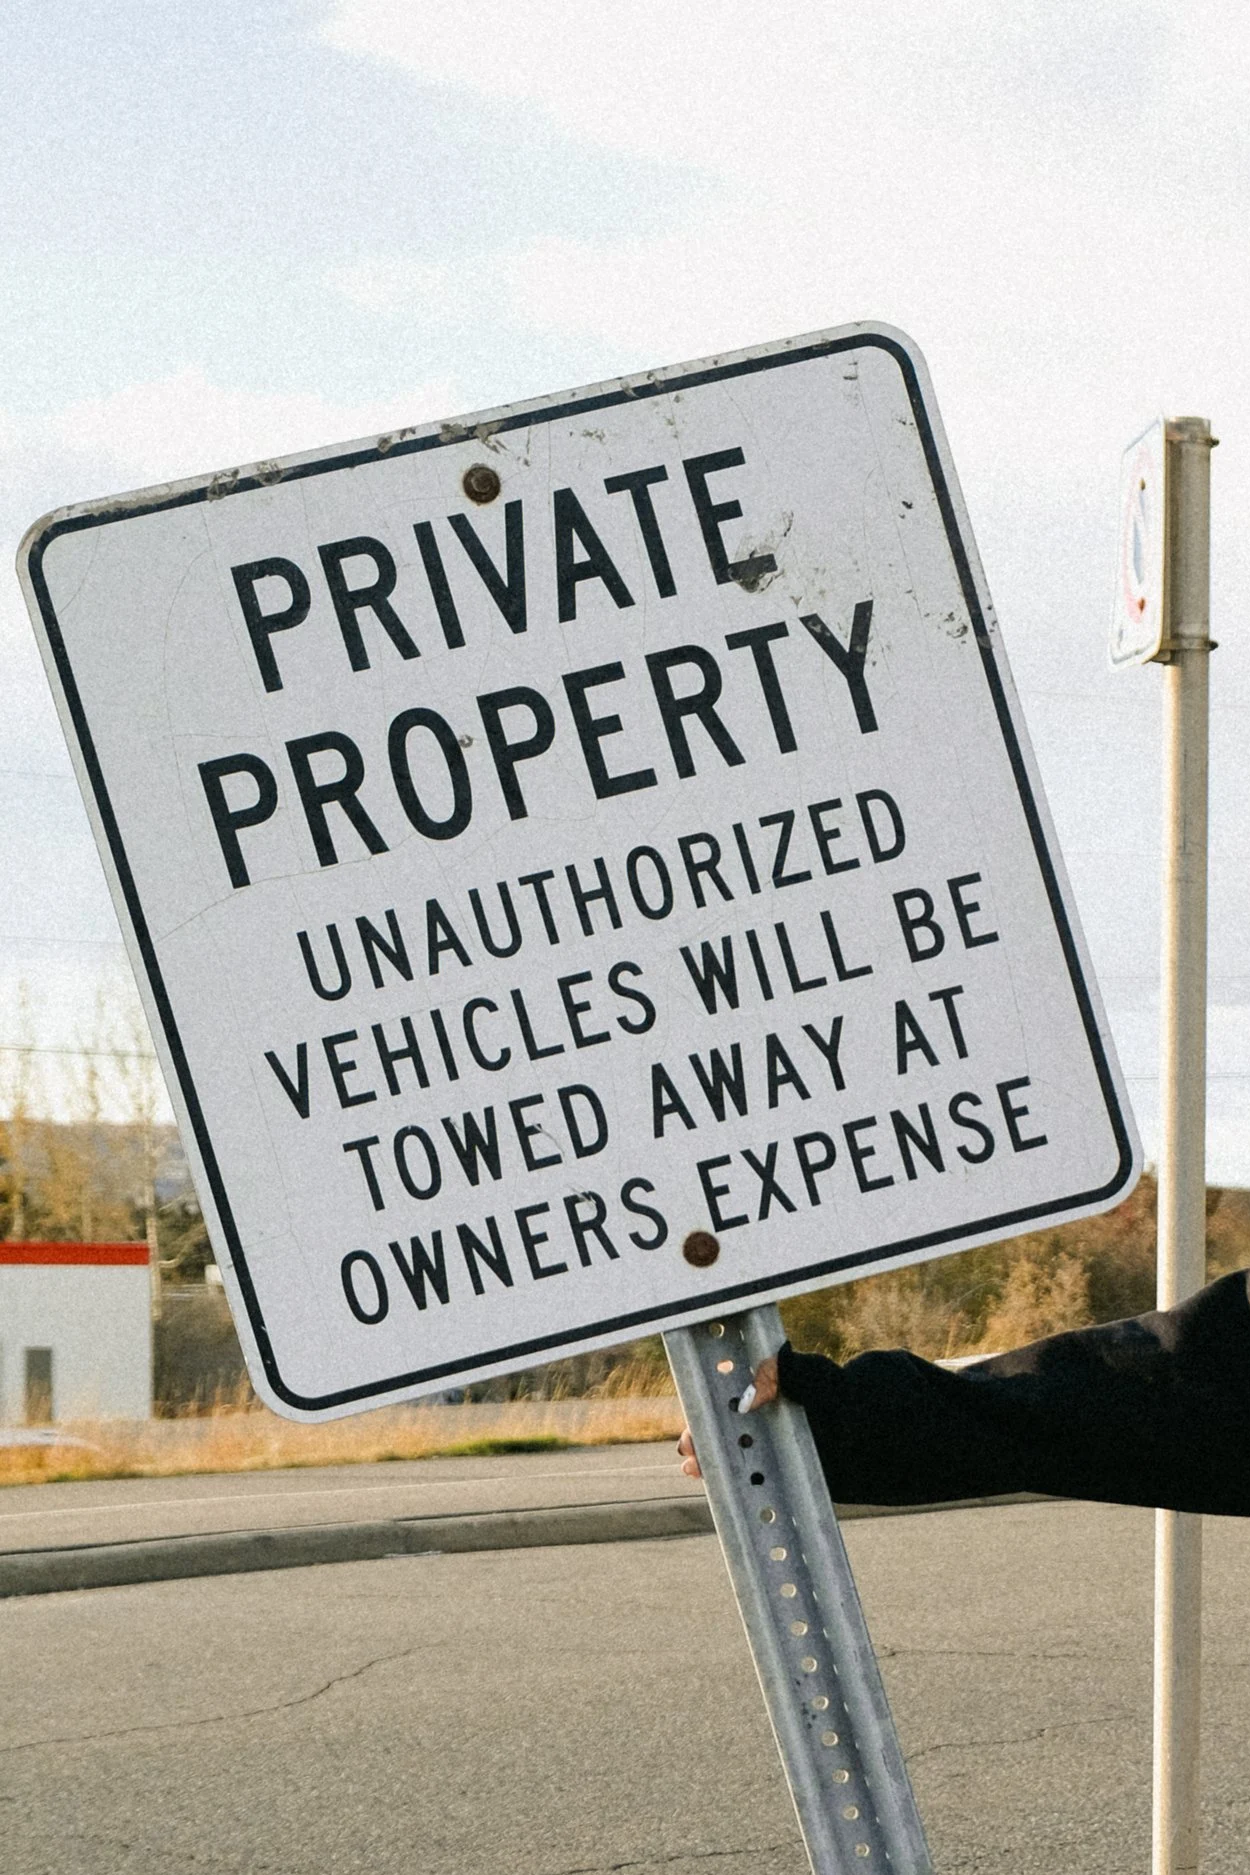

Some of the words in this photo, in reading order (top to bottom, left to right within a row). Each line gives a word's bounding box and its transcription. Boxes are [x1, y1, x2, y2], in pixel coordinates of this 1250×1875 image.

[231, 447, 778, 692] PRIVATE
[197, 600, 879, 888] PROPERTY
[265, 962, 656, 1119] VEHICLES
[680, 910, 873, 1015] WILL
[893, 872, 999, 963] BE
[297, 789, 906, 1000] UNAUTHORIZED
[341, 1177, 668, 1325] OWNERS
[697, 1076, 1047, 1233] EXPENSE
[343, 1085, 609, 1211] TOWED
[652, 1016, 845, 1139] AWAY
[895, 985, 968, 1074] AT
